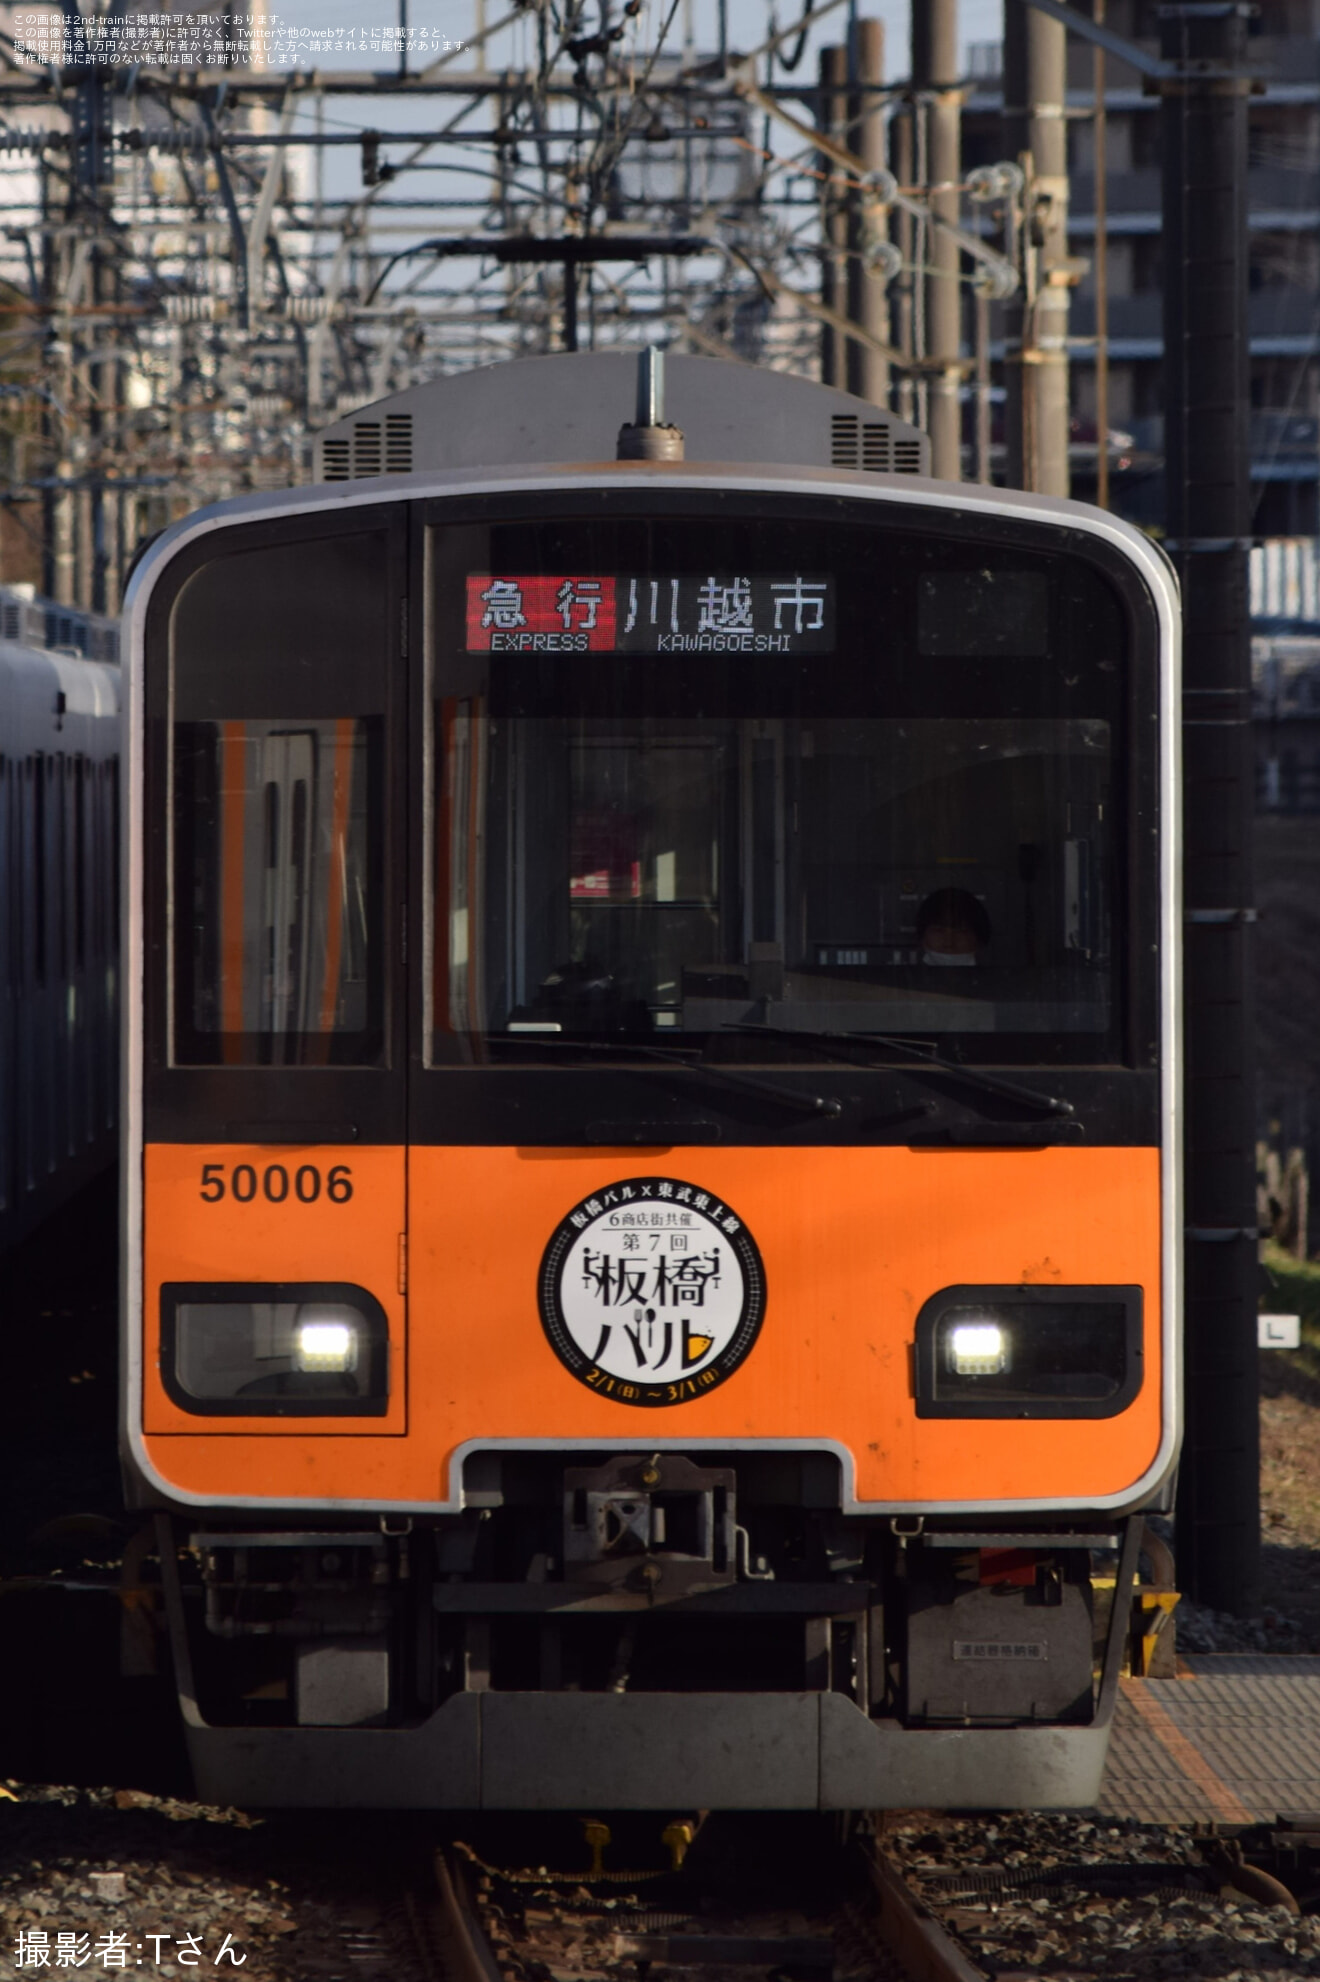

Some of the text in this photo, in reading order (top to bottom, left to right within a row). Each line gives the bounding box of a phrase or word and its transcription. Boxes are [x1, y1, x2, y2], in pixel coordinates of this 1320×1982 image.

[481, 577, 827, 633] 急行 川越市
[491, 633, 790, 652] EXPRESS KAWAGOESHI
[199, 1164, 354, 1204] 50006
[609, 1212, 693, 1227] 6商店街共催
[622, 1233, 688, 1252] 第7回
[594, 1254, 708, 1307] 板橋
[592, 1308, 715, 1370] バル
